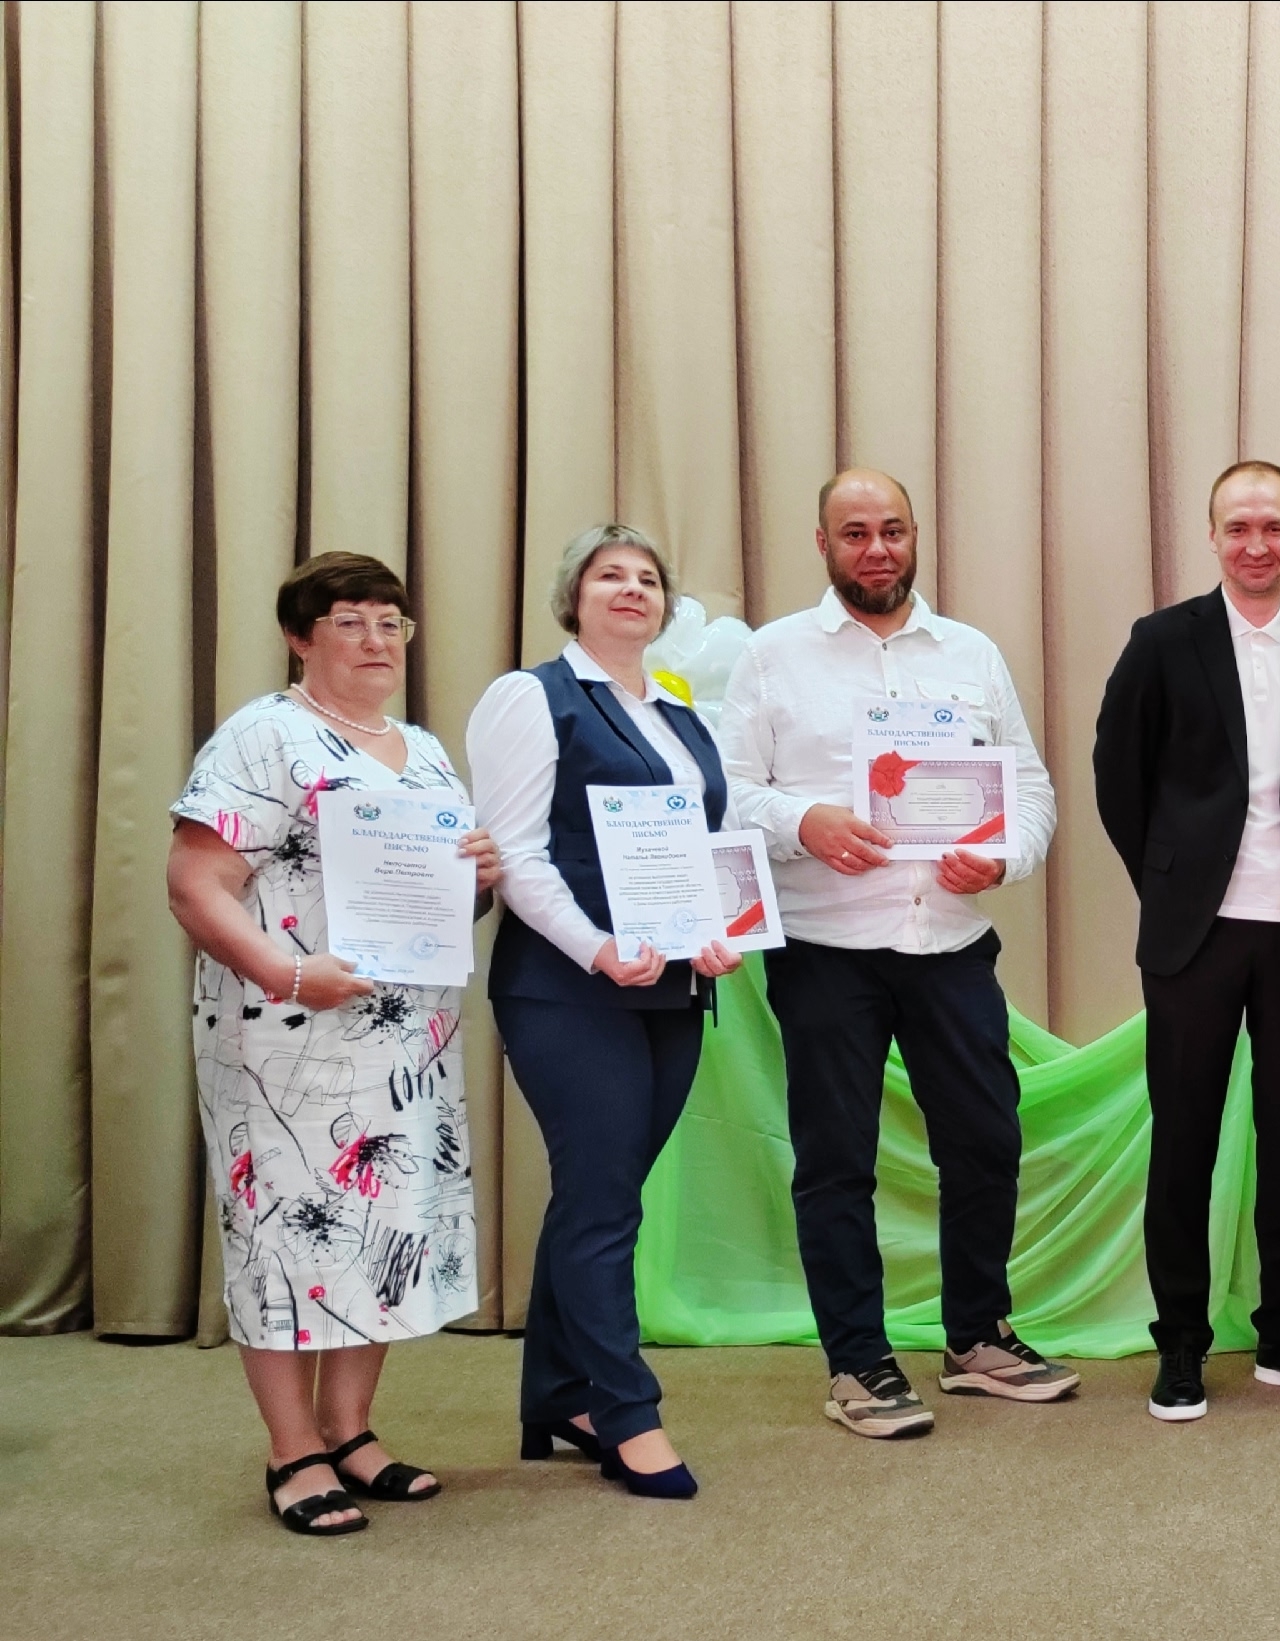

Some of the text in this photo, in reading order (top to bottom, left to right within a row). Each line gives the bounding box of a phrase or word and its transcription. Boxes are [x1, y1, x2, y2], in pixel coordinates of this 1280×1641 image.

[867, 728, 956, 738] БЛАГОДАРСТВЕННОЕ
[606, 818, 693, 828] БЛАГОДАРСТВЕННОЕ
[351, 828, 460, 846] БЛАГОДАРСТВЕННОЕ
[632, 830, 668, 838] ПИСЬМО
[383, 842, 429, 854] ПИСЬМО
